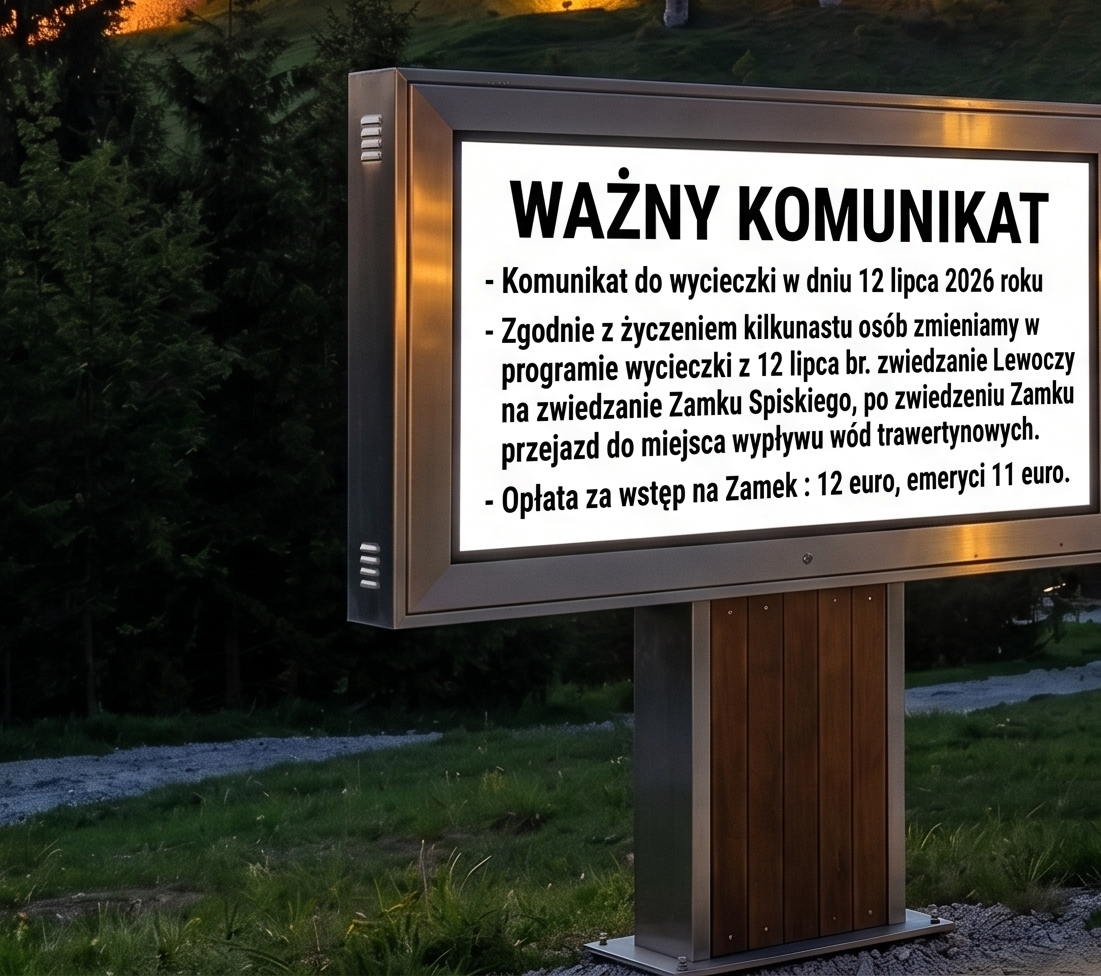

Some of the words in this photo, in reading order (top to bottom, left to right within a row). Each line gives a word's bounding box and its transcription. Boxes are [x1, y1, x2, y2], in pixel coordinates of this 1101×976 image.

[509, 166, 721, 241] WAŻNY
[738, 185, 1050, 244] KOMUNIKAT
[502, 265, 628, 294] Komunikat
[634, 265, 663, 294] do
[669, 265, 776, 301] wycieczki
[782, 273, 800, 293] w
[806, 266, 852, 294] dniu
[859, 267, 884, 293] 12
[891, 266, 939, 300] lipca
[945, 267, 995, 293] 2026
[1000, 266, 1043, 293] roku
[501, 315, 595, 351] Zgodnie
[601, 322, 614, 342] z
[620, 314, 737, 349] życzeniem
[744, 313, 853, 340] kilkunastu
[858, 311, 908, 339] osób
[913, 311, 1020, 343] zmieniamy
[1024, 317, 1040, 336] w
[501, 353, 619, 391] programie
[625, 351, 732, 387] wycieczki
[738, 358, 751, 378] z
[758, 351, 783, 377] 12
[790, 349, 840, 383] lipca
[845, 348, 871, 375] br.
[877, 346, 988, 374] zwiedzanie
[993, 347, 1076, 376] Lewoczy
[501, 402, 529, 423] na
[536, 391, 663, 422] zwiedzanie
[669, 388, 742, 418] Zamku
[748, 386, 857, 421] Spiskiego,
[864, 391, 889, 418] po
[894, 381, 1005, 410] zwiedzeniu
[1010, 379, 1074, 406] Zamku
[501, 431, 600, 471] przejazd
[606, 430, 635, 459] do
[641, 428, 726, 463] miejsca
[732, 424, 824, 460] wypływu
[829, 420, 871, 449] wód
[877, 415, 1040, 451] trawertynowych.
[502, 483, 579, 520] Opłata
[585, 487, 612, 509] za
[618, 481, 686, 512] wstęp
[692, 482, 719, 503] na
[725, 471, 798, 502] Zamek
[817, 470, 843, 496] 12
[849, 473, 901, 498] euro,
[907, 461, 985, 496] emeryci
[992, 461, 1013, 487] 11
[1021, 464, 1070, 486] euro.
